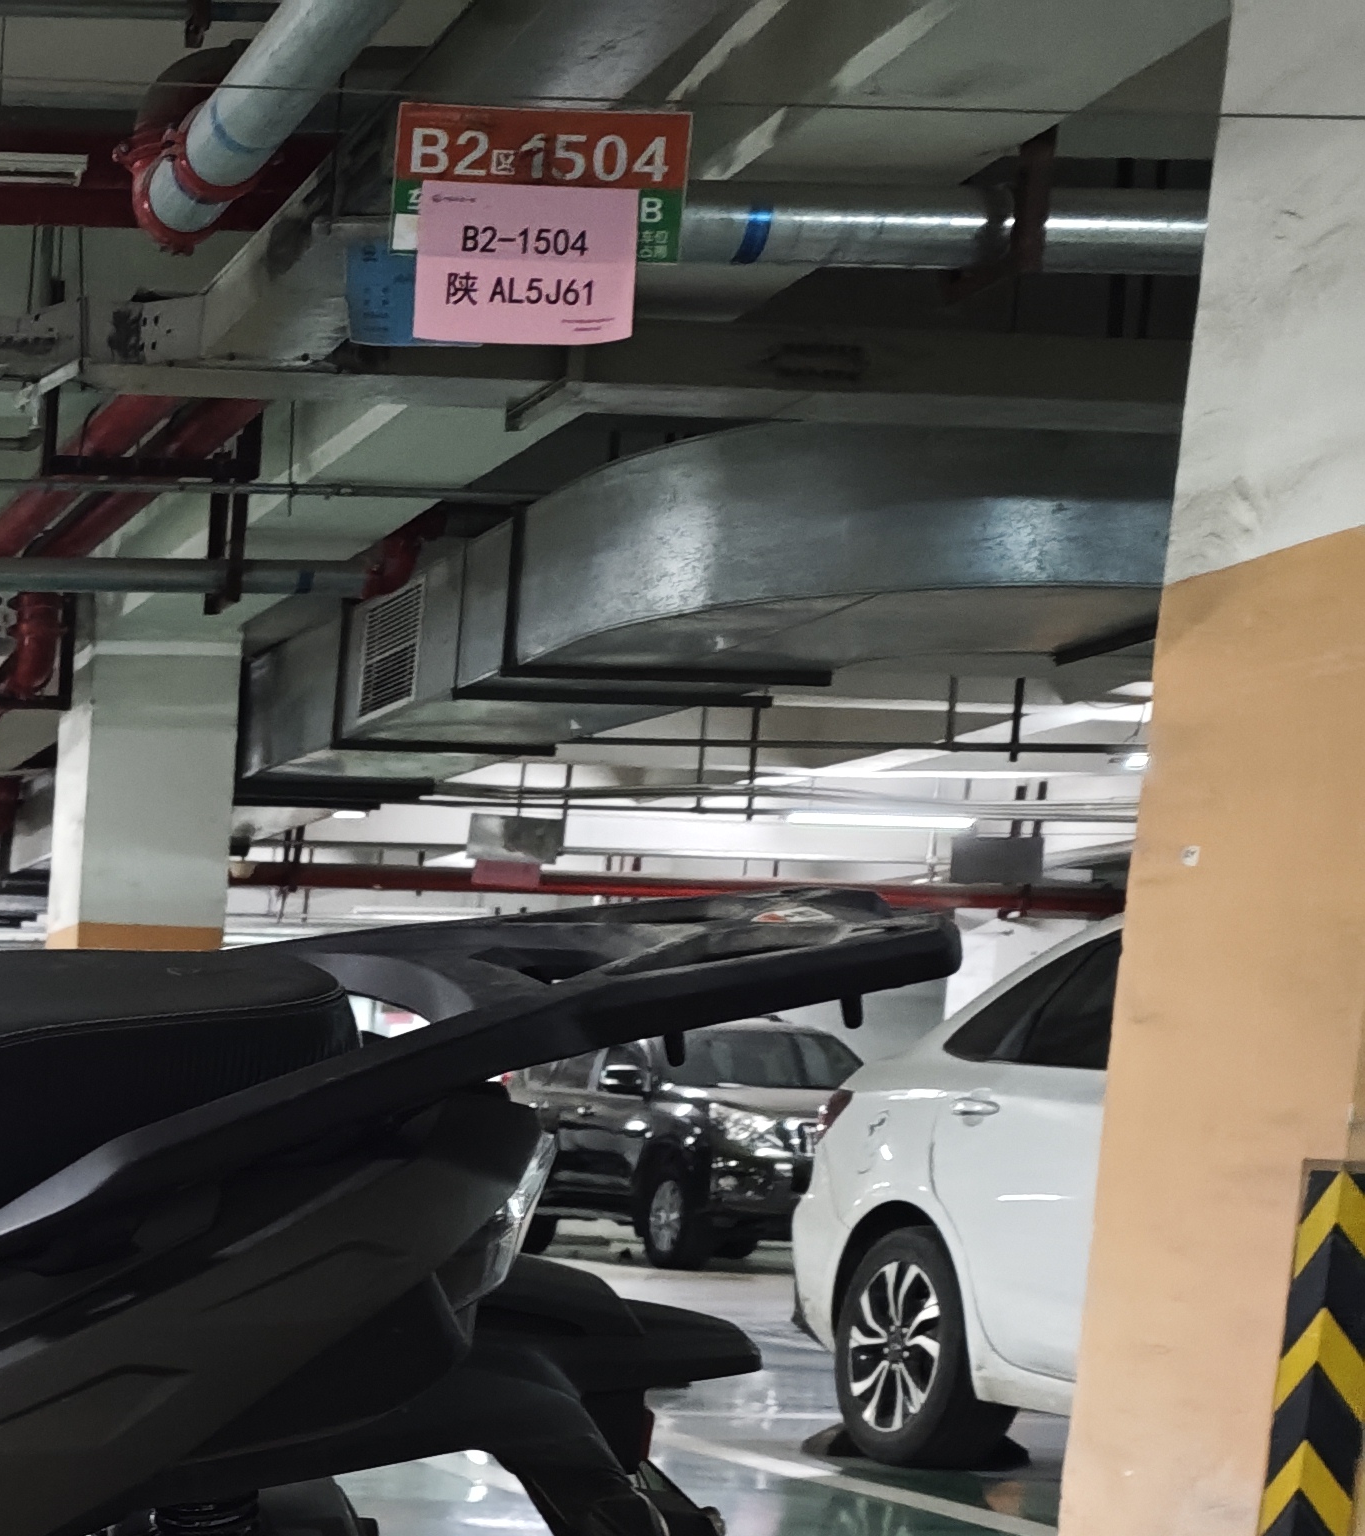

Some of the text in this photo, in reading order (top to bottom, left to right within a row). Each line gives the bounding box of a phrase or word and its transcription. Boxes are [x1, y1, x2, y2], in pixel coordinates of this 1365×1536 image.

[461, 225, 589, 256] B2-1504
[445, 272, 595, 306] 陕 AL5J61
